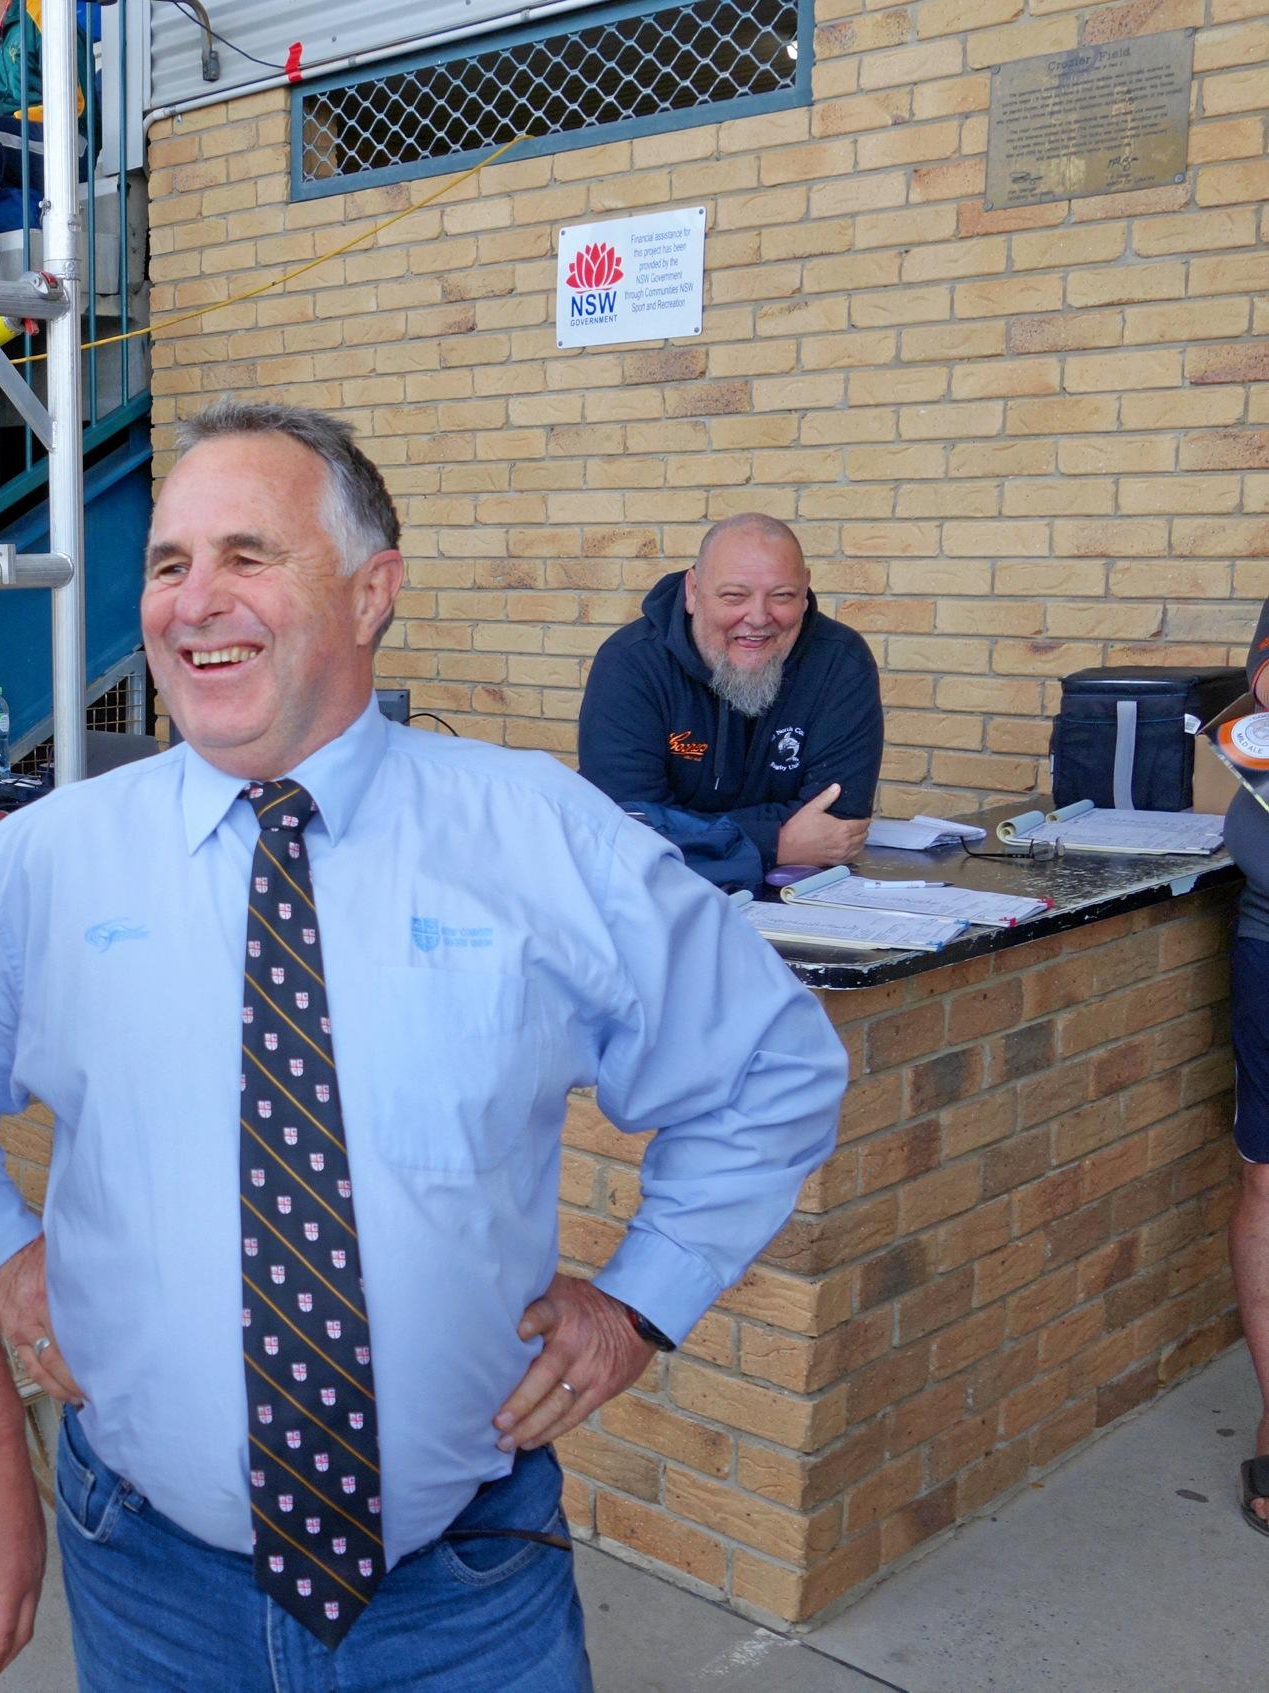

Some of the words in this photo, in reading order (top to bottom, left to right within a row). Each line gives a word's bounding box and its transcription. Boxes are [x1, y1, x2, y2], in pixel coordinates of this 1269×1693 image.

[1098, 47, 1131, 61] Field
[630, 233, 654, 244] Financial
[655, 230, 682, 241] assistance
[634, 248, 643, 257] this
[644, 246, 661, 257] project
[663, 244, 672, 254] has
[674, 243, 687, 253] been
[639, 259, 661, 272] provided
[663, 260, 668, 270] by
[670, 256, 678, 266] the
[636, 274, 649, 285] NSW
[651, 271, 682, 283] Government
[625, 289, 643, 301] through
[645, 285, 678, 298] Communities
[680, 282, 693, 293] NSW
[571, 291, 617, 317] NSW
[631, 302, 645, 314] Sport
[647, 301, 656, 311] and
[658, 299, 685, 310] Recreation
[571, 314, 618, 327] GOVERNMENT
[1237, 733, 1249, 748] MILD
[1247, 746, 1262, 755] ALE
